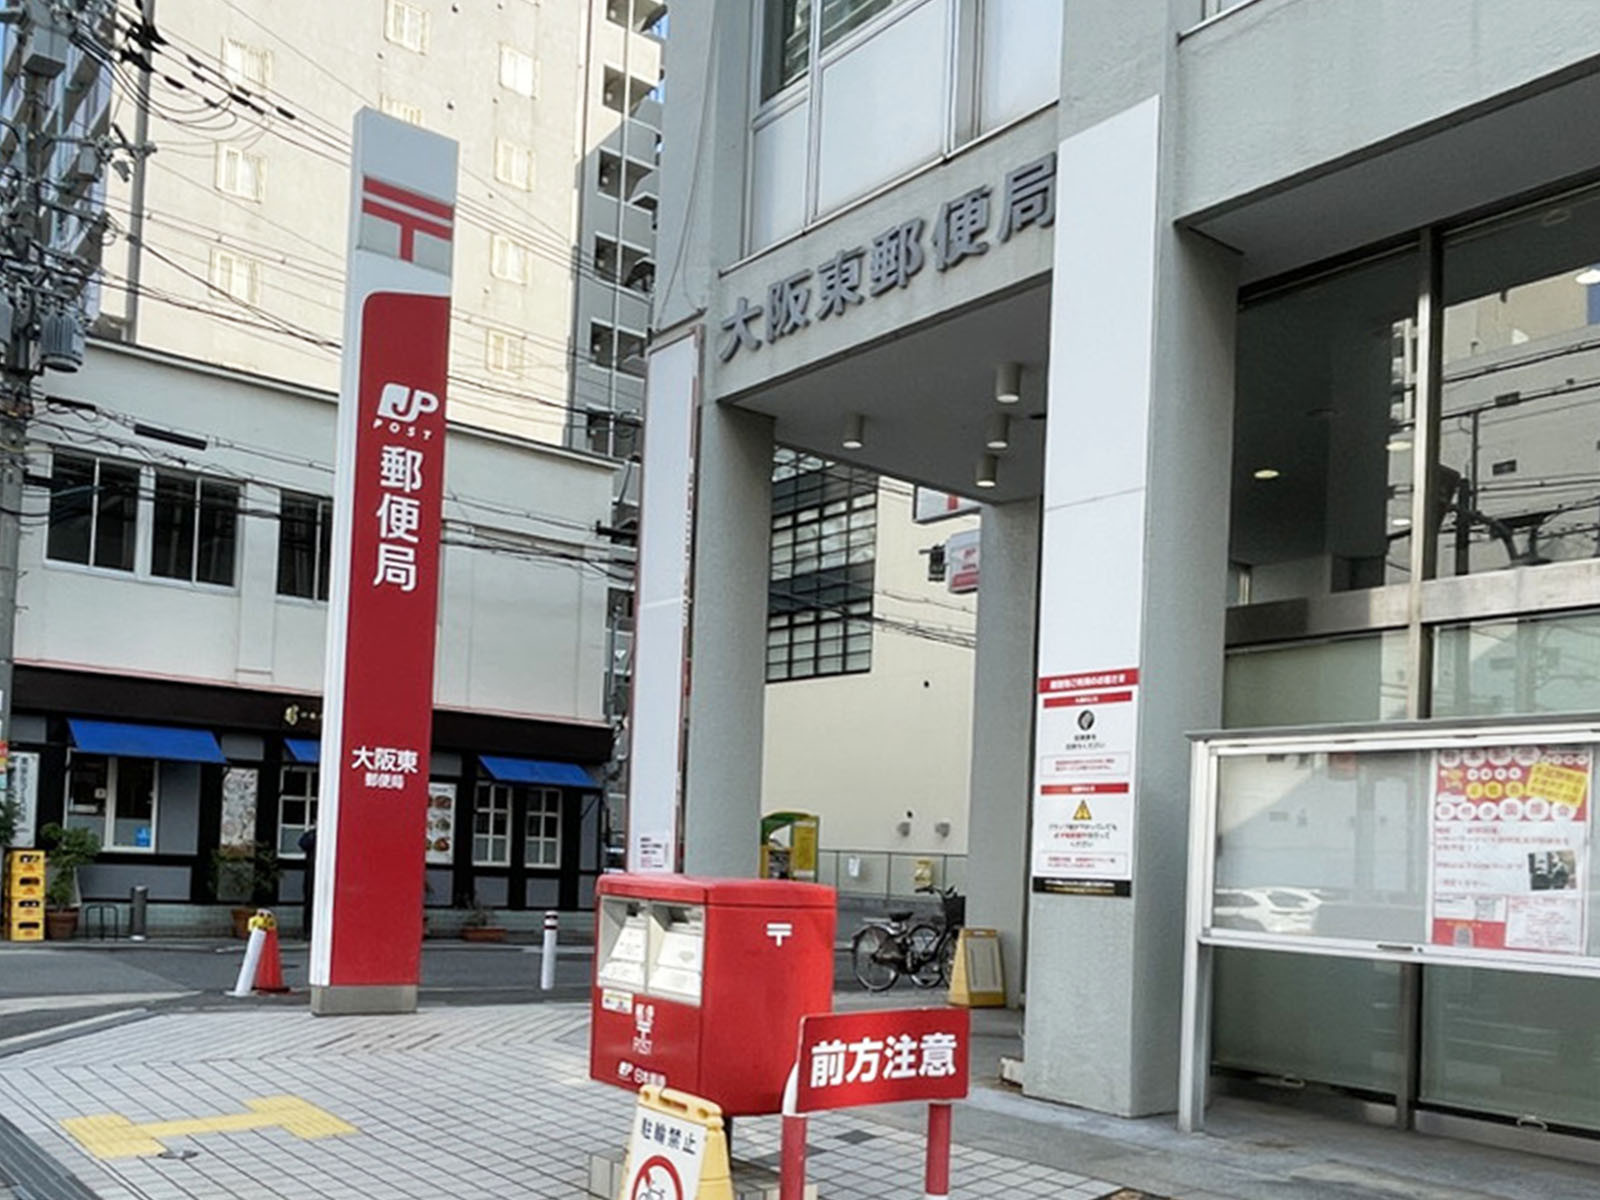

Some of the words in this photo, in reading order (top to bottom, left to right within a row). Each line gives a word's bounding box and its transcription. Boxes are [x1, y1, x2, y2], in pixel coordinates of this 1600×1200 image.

[720, 151, 1058, 363] 大阪東郵便局
[372, 418, 432, 441] POST
[373, 444, 424, 592] 郵便局
[352, 745, 419, 774] 大阪東
[365, 772, 405, 790] 郵便局
[810, 1032, 958, 1088] 前方注意
[641, 1117, 697, 1155] 駐輪禁止
